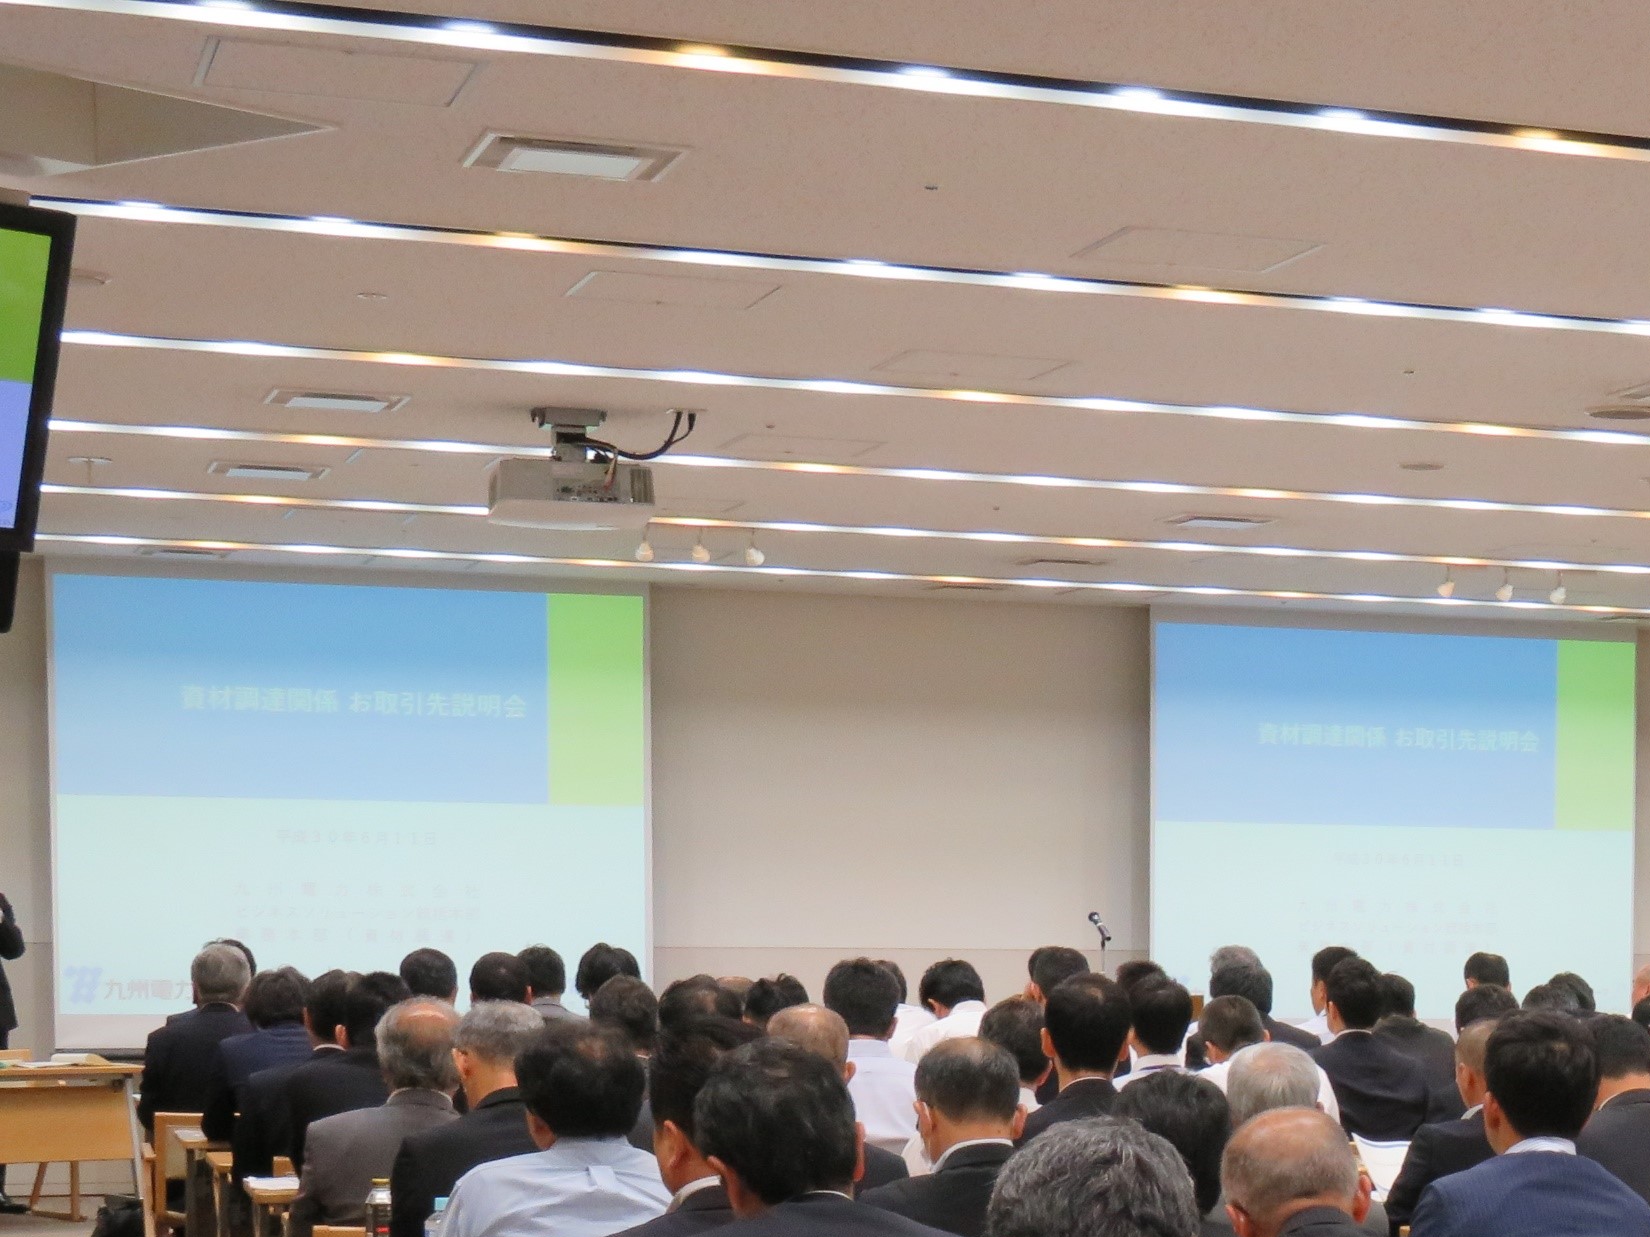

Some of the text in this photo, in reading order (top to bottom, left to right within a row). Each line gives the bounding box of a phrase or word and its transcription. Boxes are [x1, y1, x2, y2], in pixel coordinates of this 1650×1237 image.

[182, 685, 527, 718] 資材調達関係 お取引先説明会
[1258, 722, 1540, 752] 資材調達関係 お取引先説明会
